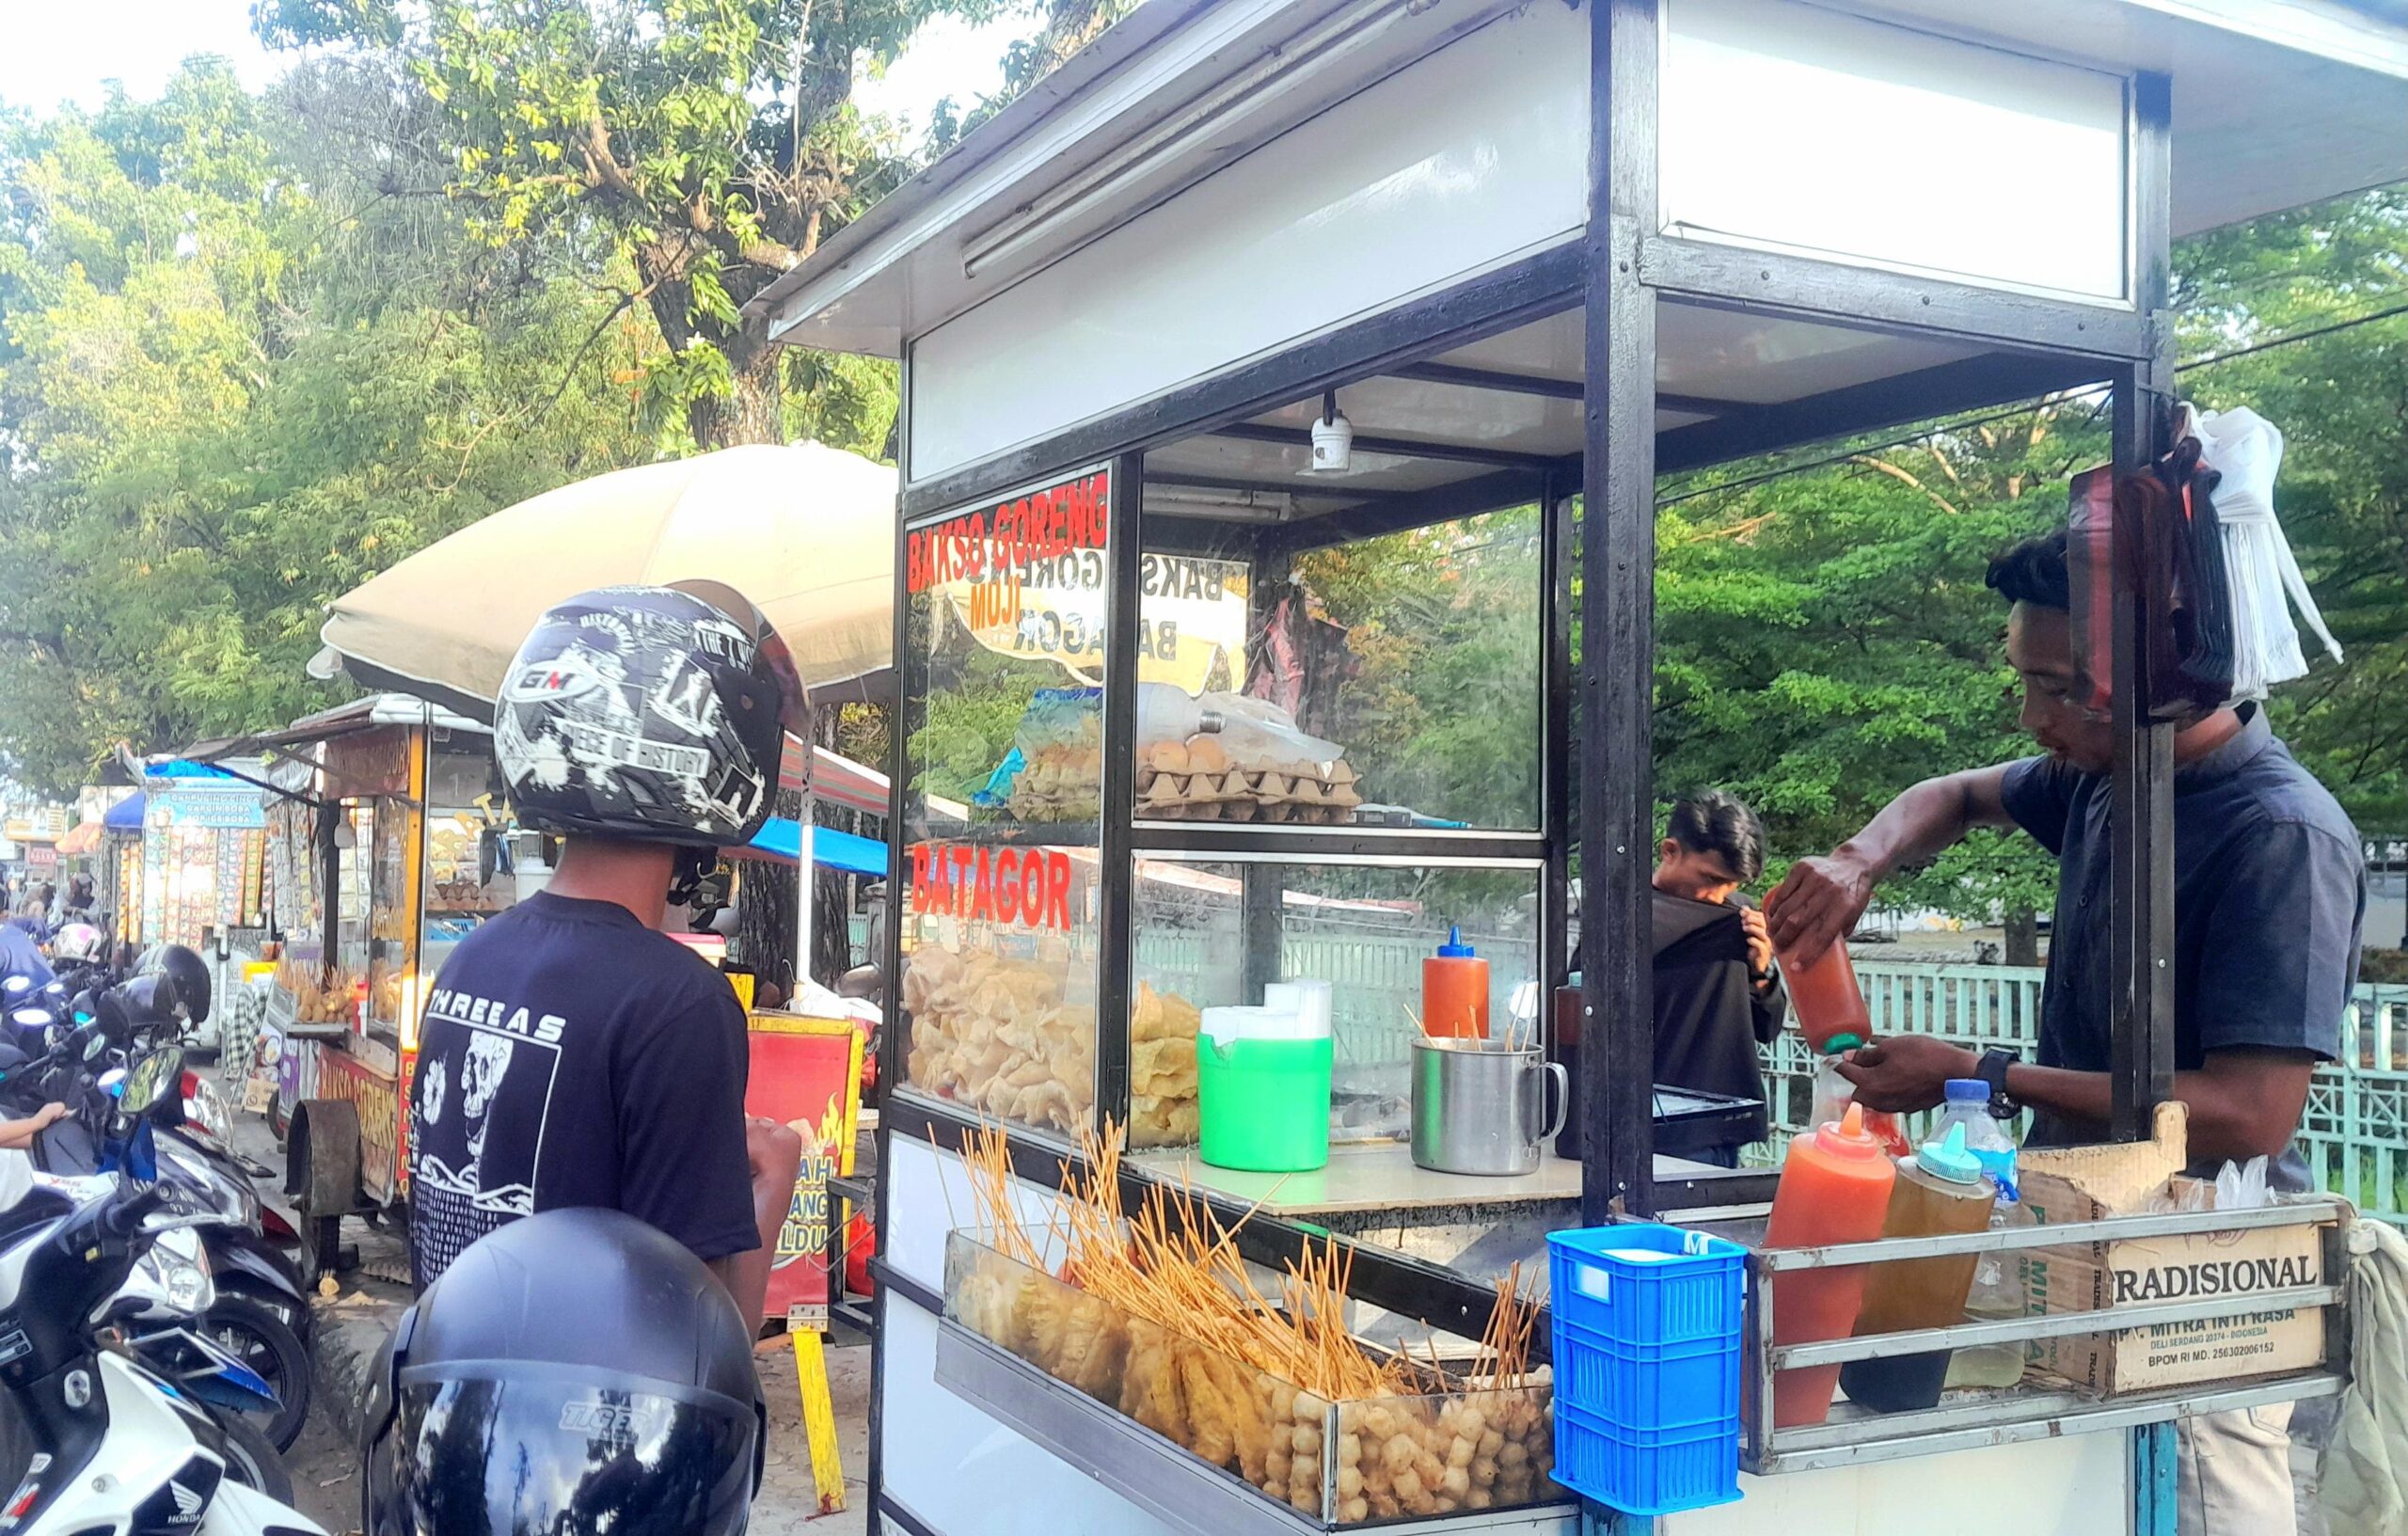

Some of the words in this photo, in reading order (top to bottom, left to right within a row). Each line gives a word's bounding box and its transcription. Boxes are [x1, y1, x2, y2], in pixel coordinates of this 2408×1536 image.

[907, 513, 986, 594] BAKSO
[992, 471, 1107, 568] GORENG
[970, 574, 1022, 631] MUJI
[912, 844, 1072, 931] BATAGOR
[798, 1156, 833, 1184] AH
[787, 1190, 830, 1219] ANG
[776, 1226, 828, 1254] LDU
[2112, 1256, 2318, 1303] RADISIONAL
[2148, 1354, 2178, 1367] BPOM
[2180, 1353, 2190, 1363] RI
[2193, 1350, 2210, 1362] MD.
[167, 1513, 201, 1524] HONDA
